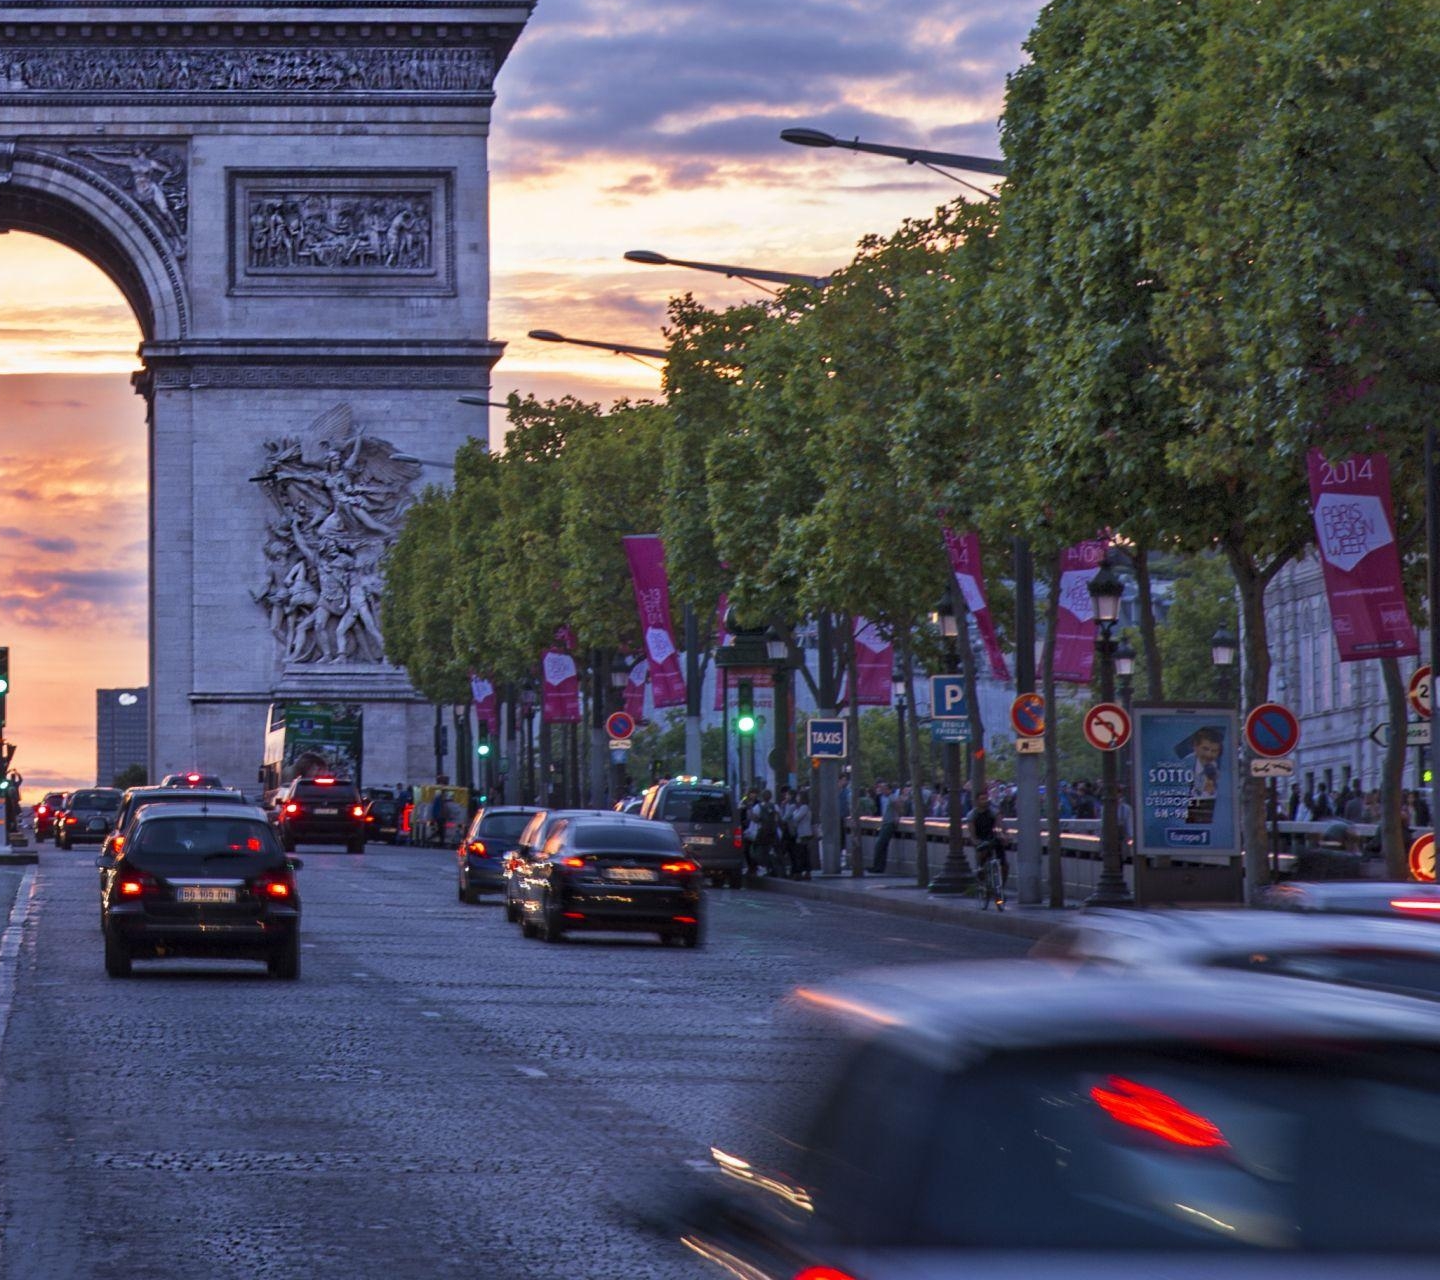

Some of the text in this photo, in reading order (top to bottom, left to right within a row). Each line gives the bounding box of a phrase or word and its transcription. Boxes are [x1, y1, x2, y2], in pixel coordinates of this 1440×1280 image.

[1320, 459, 1374, 485] 2014
[1322, 503, 1362, 523] PARIS
[1324, 519, 1375, 540] DESIGN
[1326, 536, 1368, 556] WEEK
[945, 684, 964, 711] P
[812, 732, 841, 744] TAXIS
[1148, 768, 1194, 783] SOTTO
